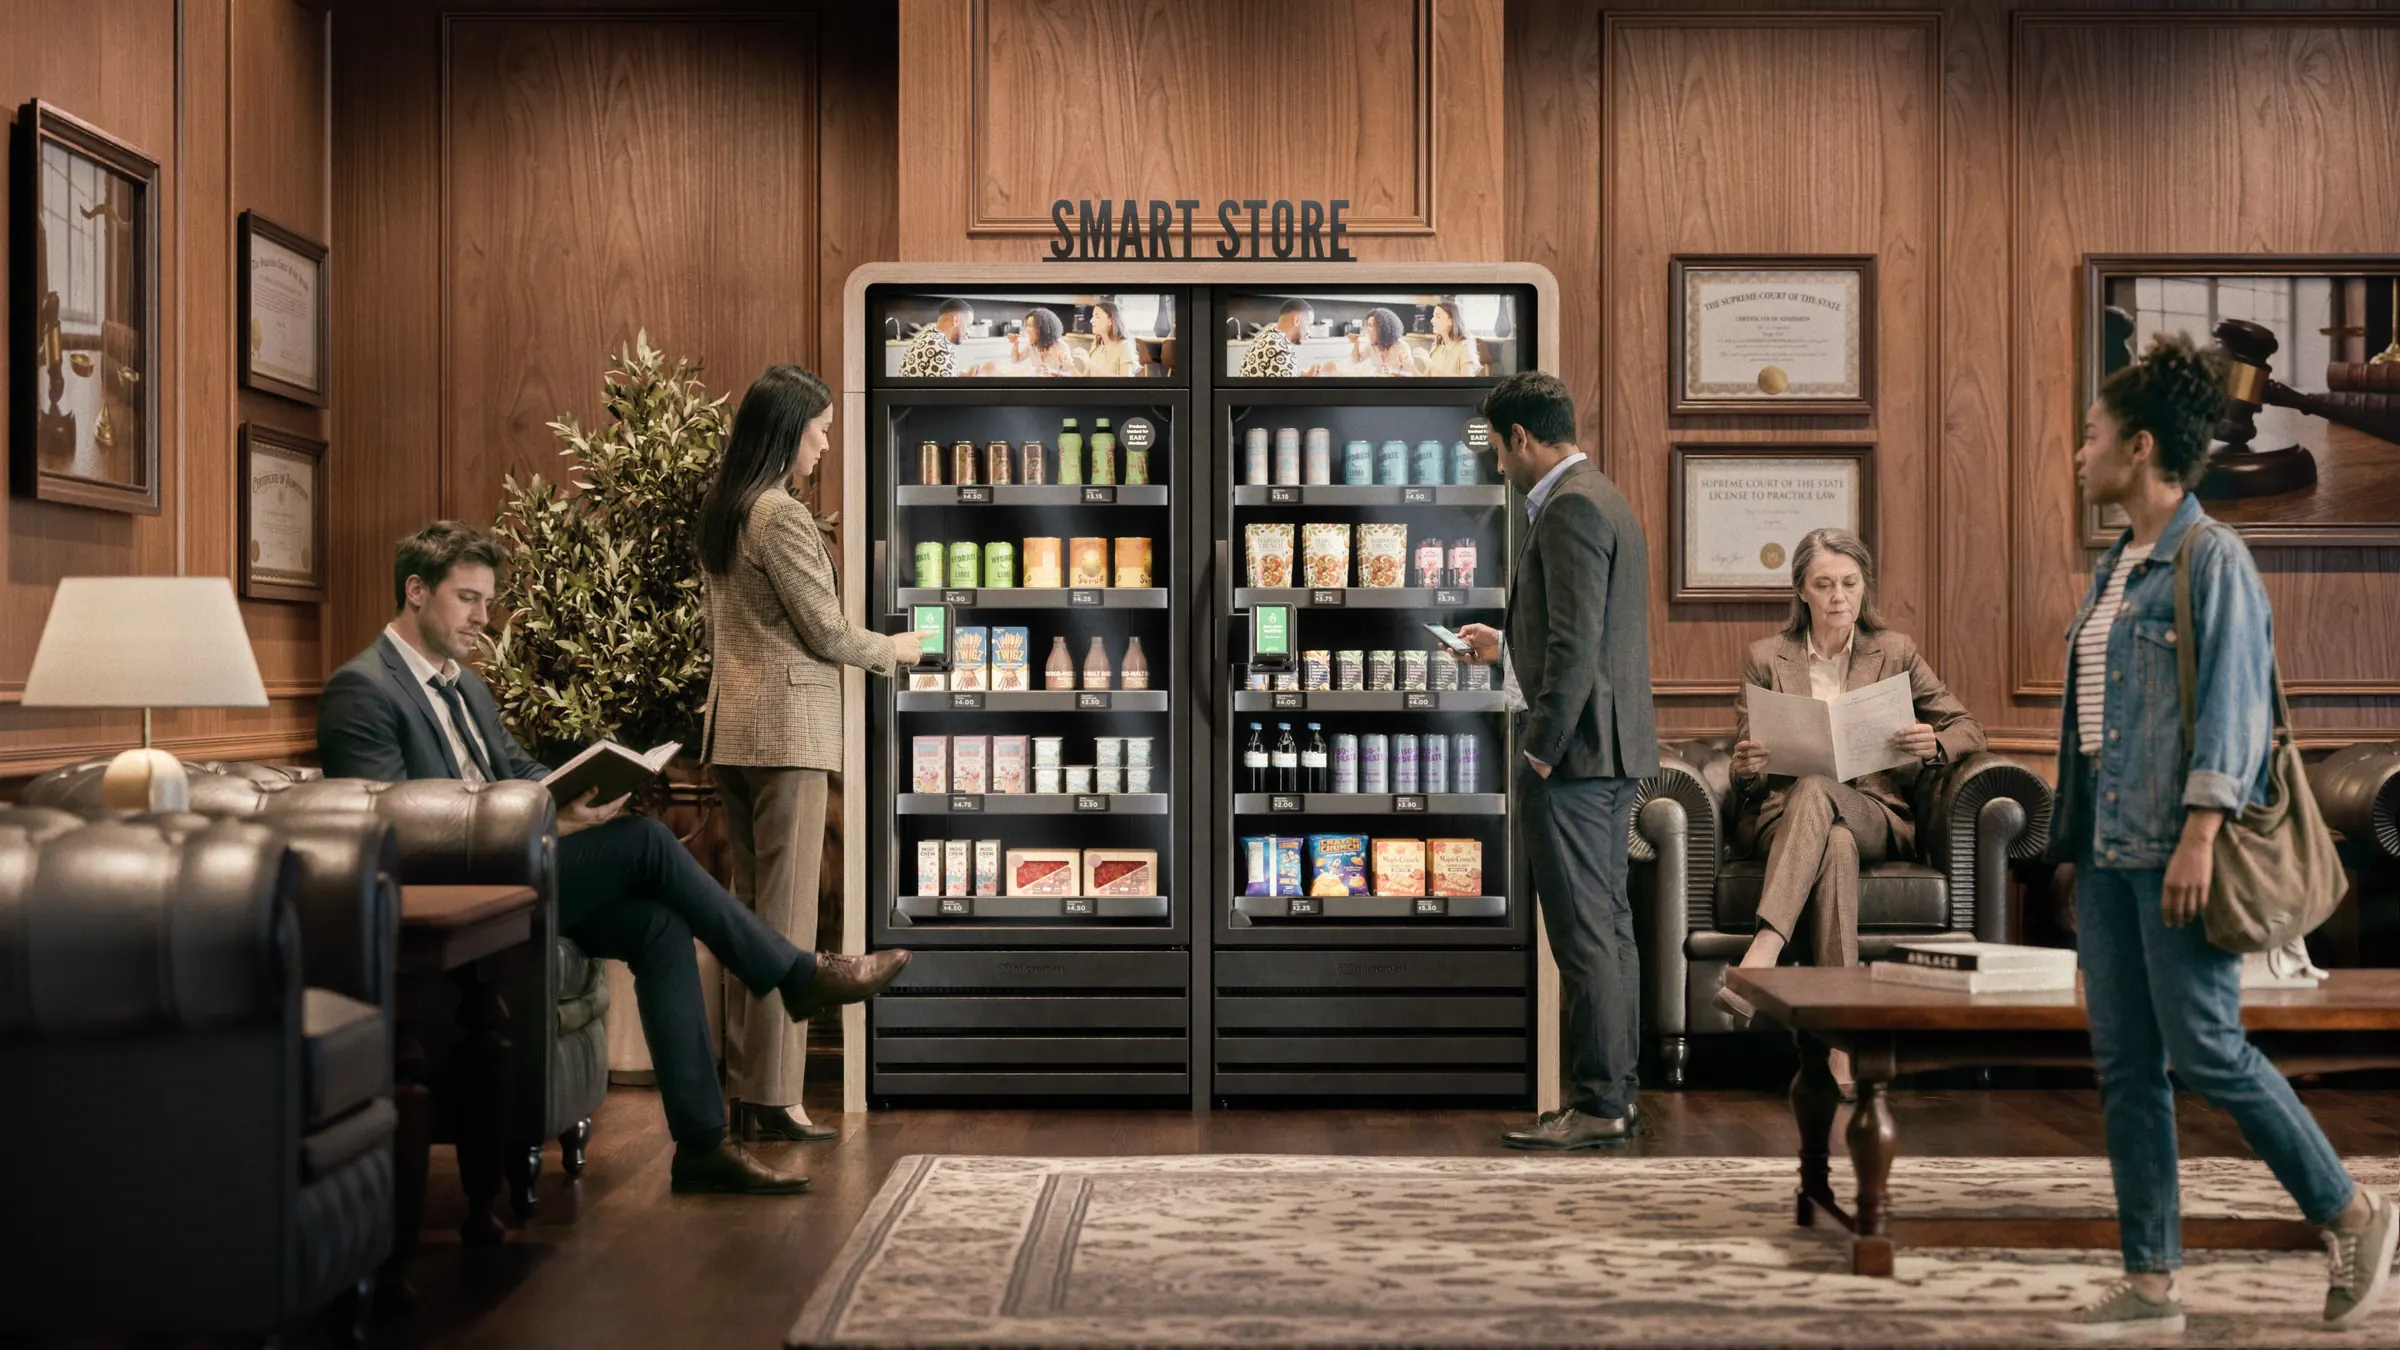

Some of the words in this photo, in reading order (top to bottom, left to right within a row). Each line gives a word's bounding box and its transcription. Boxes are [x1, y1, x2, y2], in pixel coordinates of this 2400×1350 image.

[1050, 199, 1199, 259] SMART
[1216, 199, 1350, 259] STORE
[1704, 301, 1720, 311] THE
[1721, 293, 1757, 306] SUPREME
[1758, 291, 1787, 299] COURT
[1788, 292, 1800, 300] OF
[1800, 294, 1817, 305] THE
[1815, 299, 1841, 312] STATE
[1700, 479, 1743, 488] SUPREME
[1745, 479, 1779, 488] COURT
[1781, 479, 1793, 488] OF
[1797, 479, 1816, 488] THE
[1818, 479, 1845, 488] STATE
[1709, 491, 1748, 500] LICENSE
[1751, 491, 1765, 500] TO
[1767, 491, 1814, 500] PRACTICE
[1816, 491, 1837, 500] LAW
[955, 650, 984, 661] TWIGZ
[995, 650, 1025, 661] TWIGZ
[1320, 837, 1360, 847] CRATER
[1320, 843, 1360, 853] CRUNCH
